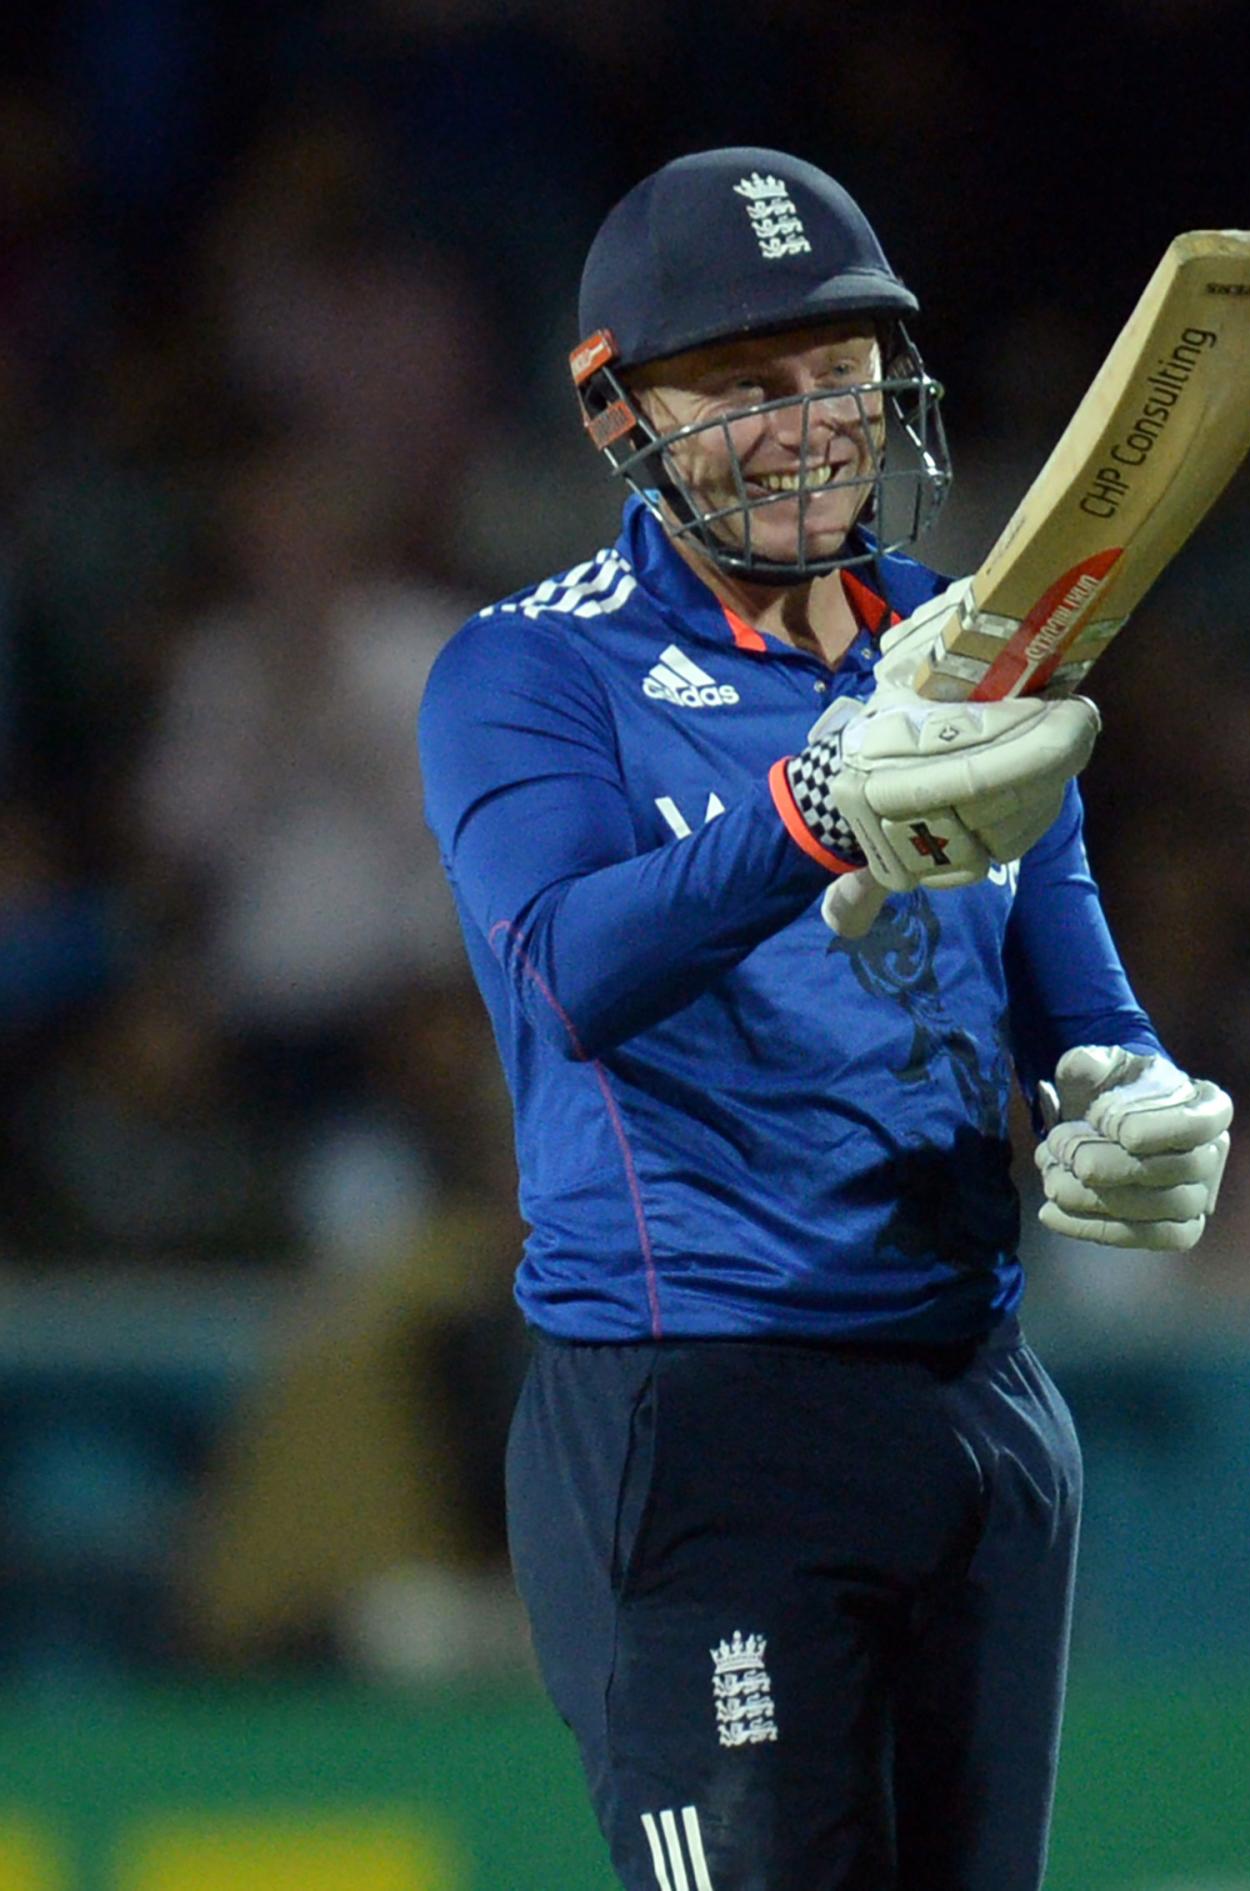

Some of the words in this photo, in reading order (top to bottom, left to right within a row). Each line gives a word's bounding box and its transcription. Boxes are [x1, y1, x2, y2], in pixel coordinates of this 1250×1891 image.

[1080, 466, 1131, 520] CHP
[1111, 326, 1217, 467] Consulting
[642, 676, 740, 709] adidas
